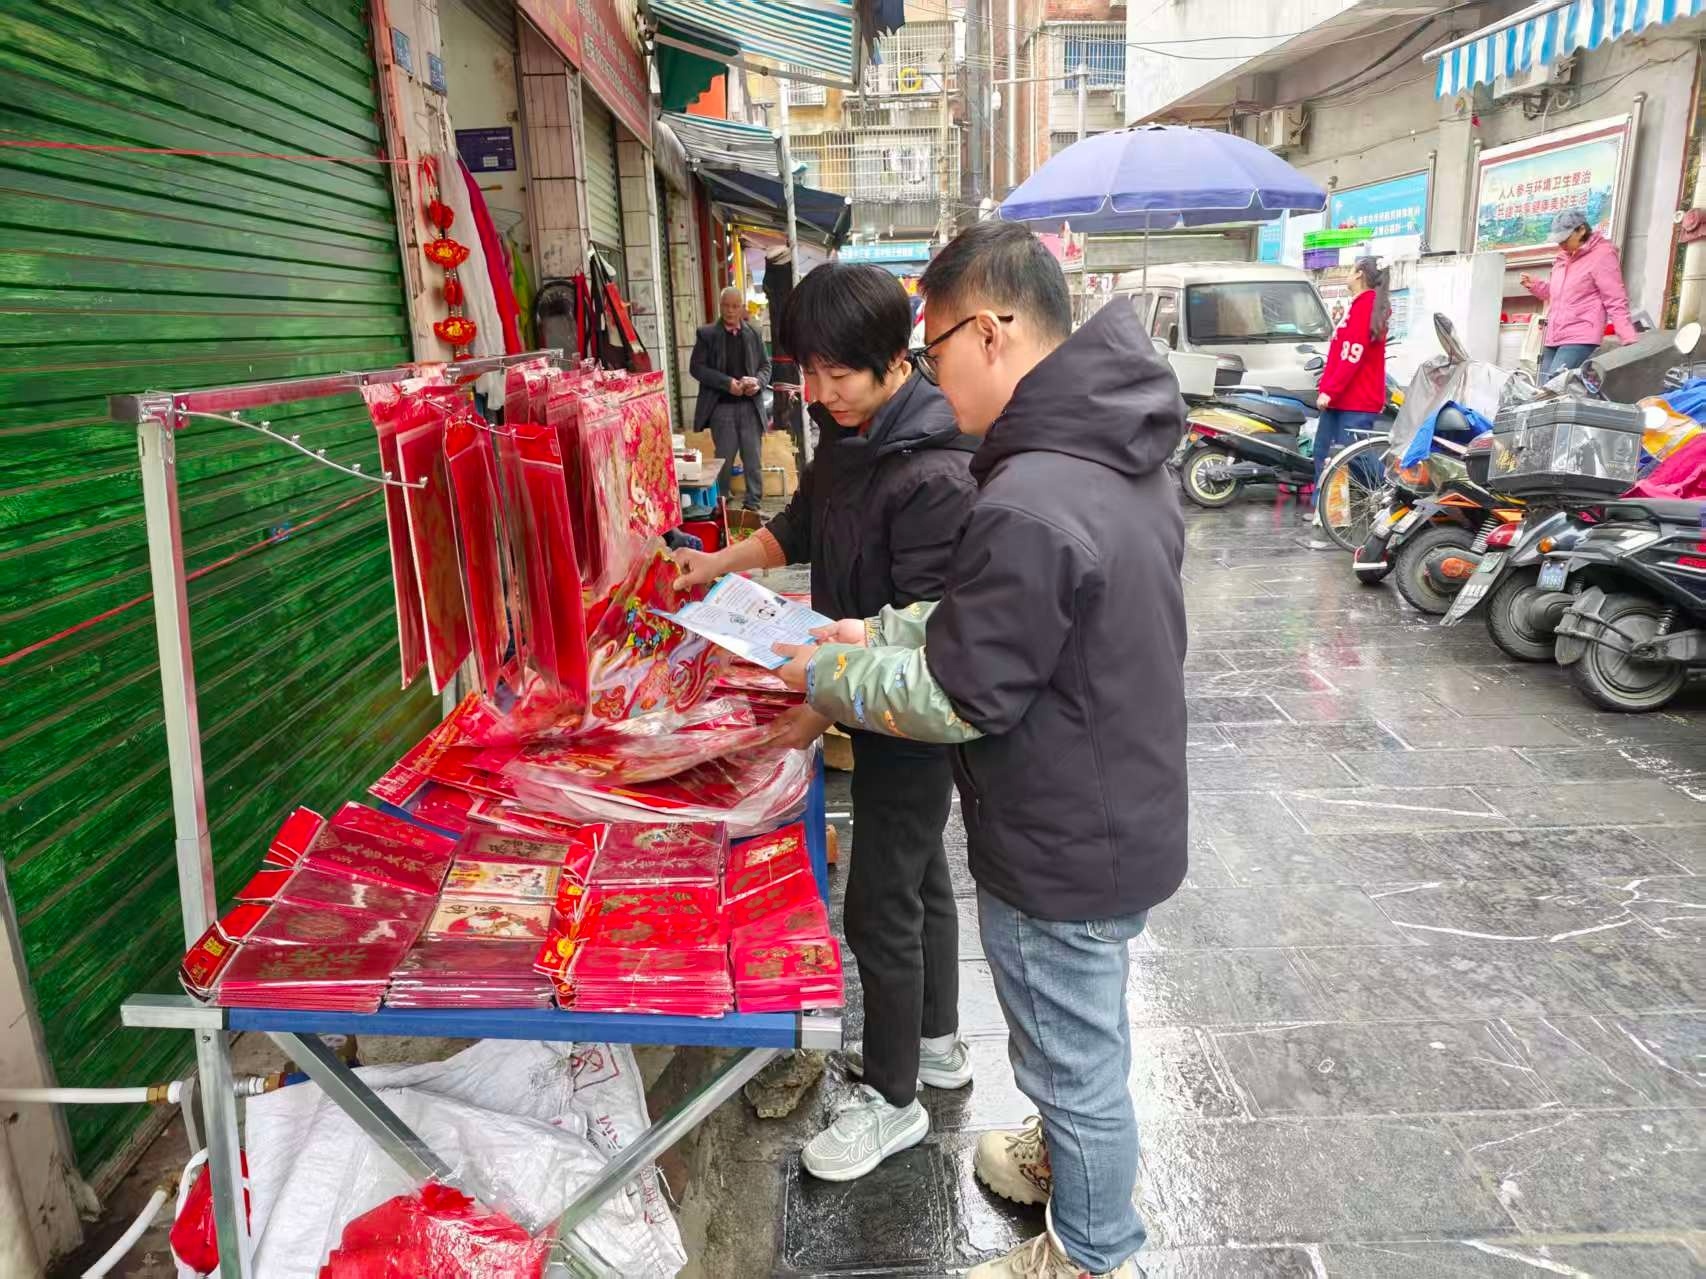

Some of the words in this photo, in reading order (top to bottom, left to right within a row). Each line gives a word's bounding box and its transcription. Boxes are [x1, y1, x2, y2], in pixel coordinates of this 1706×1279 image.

[1498, 169, 1592, 201] 人人参与环境卫生整治
[1340, 341, 1364, 364] 89
